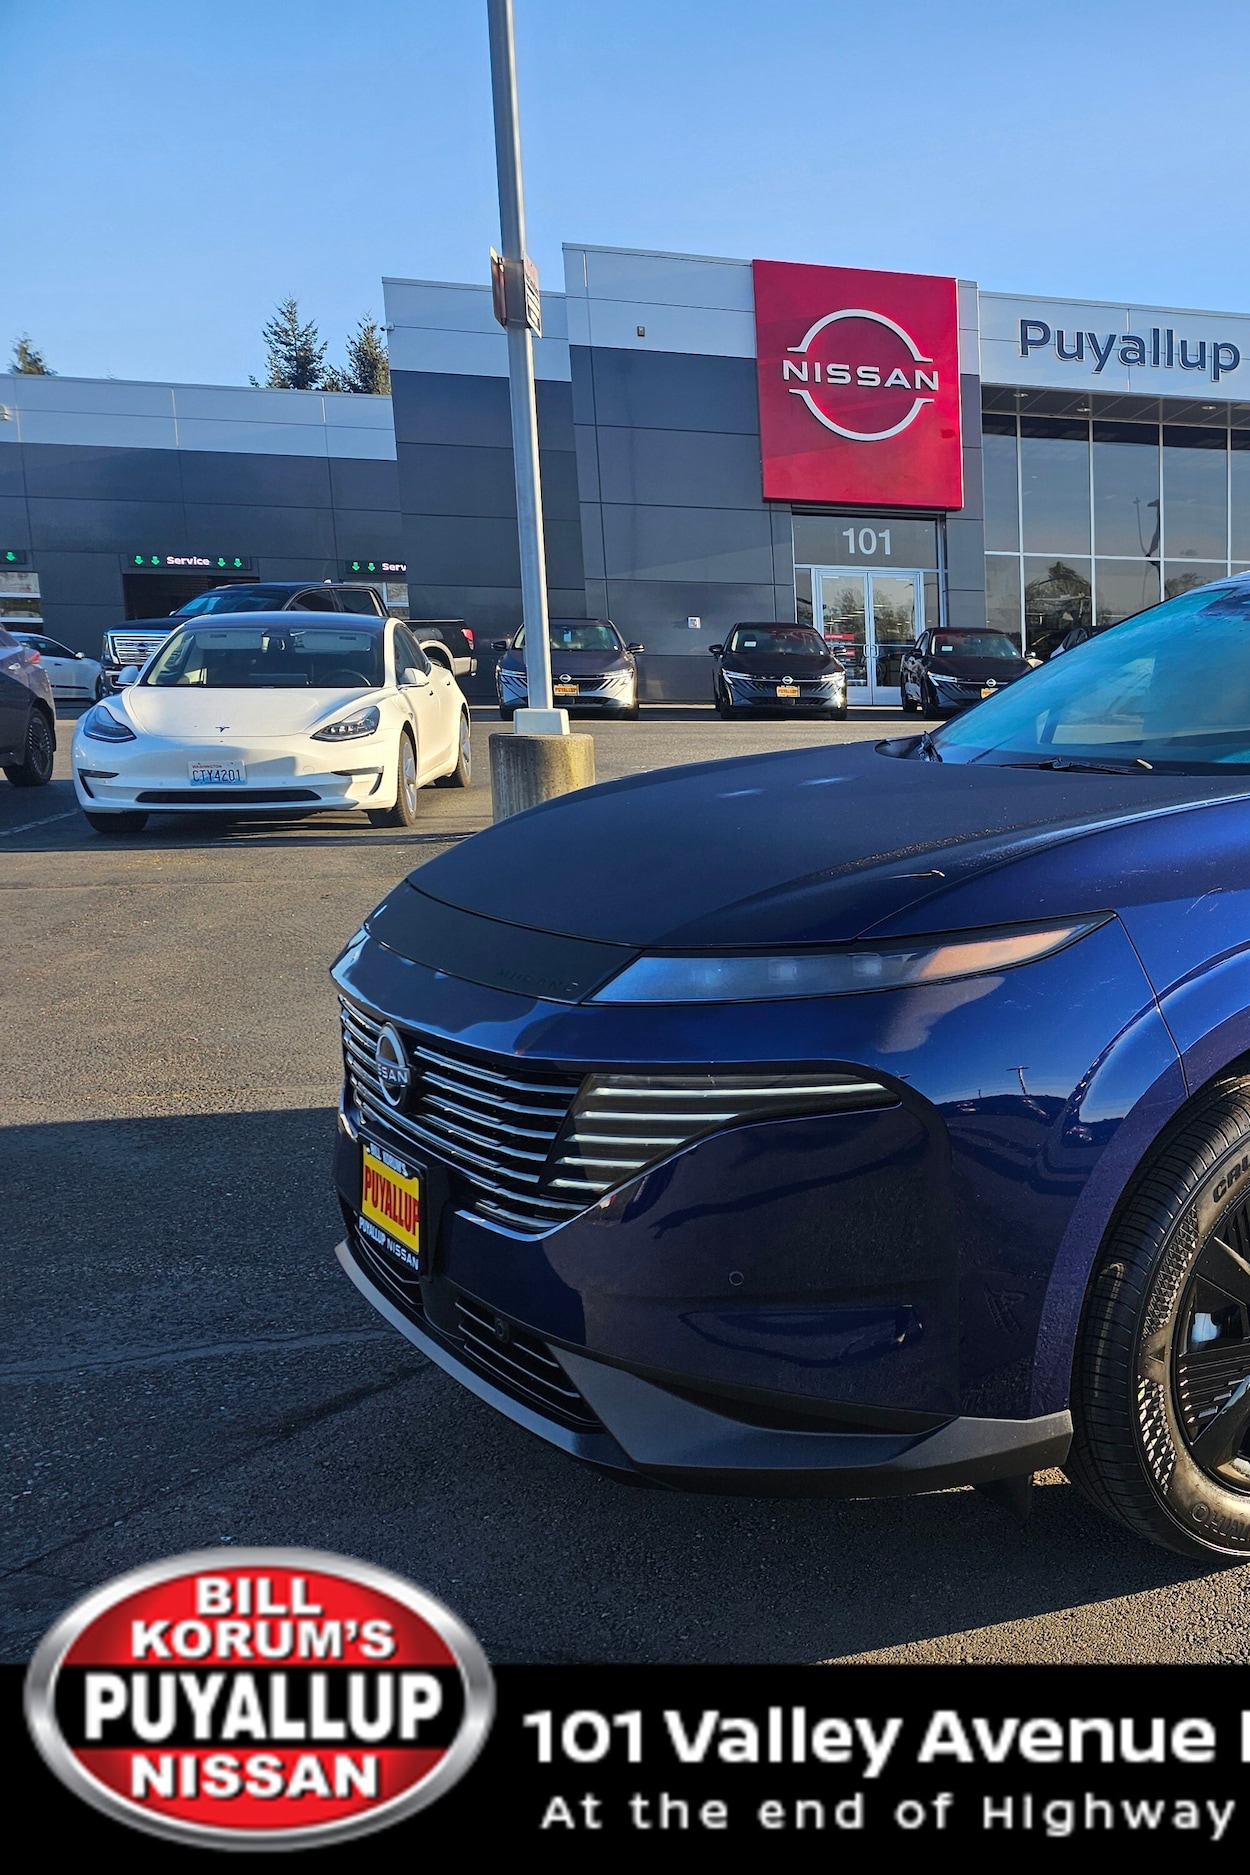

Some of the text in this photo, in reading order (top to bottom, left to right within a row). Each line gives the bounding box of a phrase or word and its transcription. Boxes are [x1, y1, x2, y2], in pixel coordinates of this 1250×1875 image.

[1019, 318, 1241, 382] Puyallup
[783, 359, 939, 391] NISSAN
[842, 527, 892, 556] 101
[166, 556, 211, 567] Service
[192, 769, 241, 782] CTY4201
[364, 1164, 420, 1237] PUYALLUP
[387, 1237, 419, 1271] NISSAN
